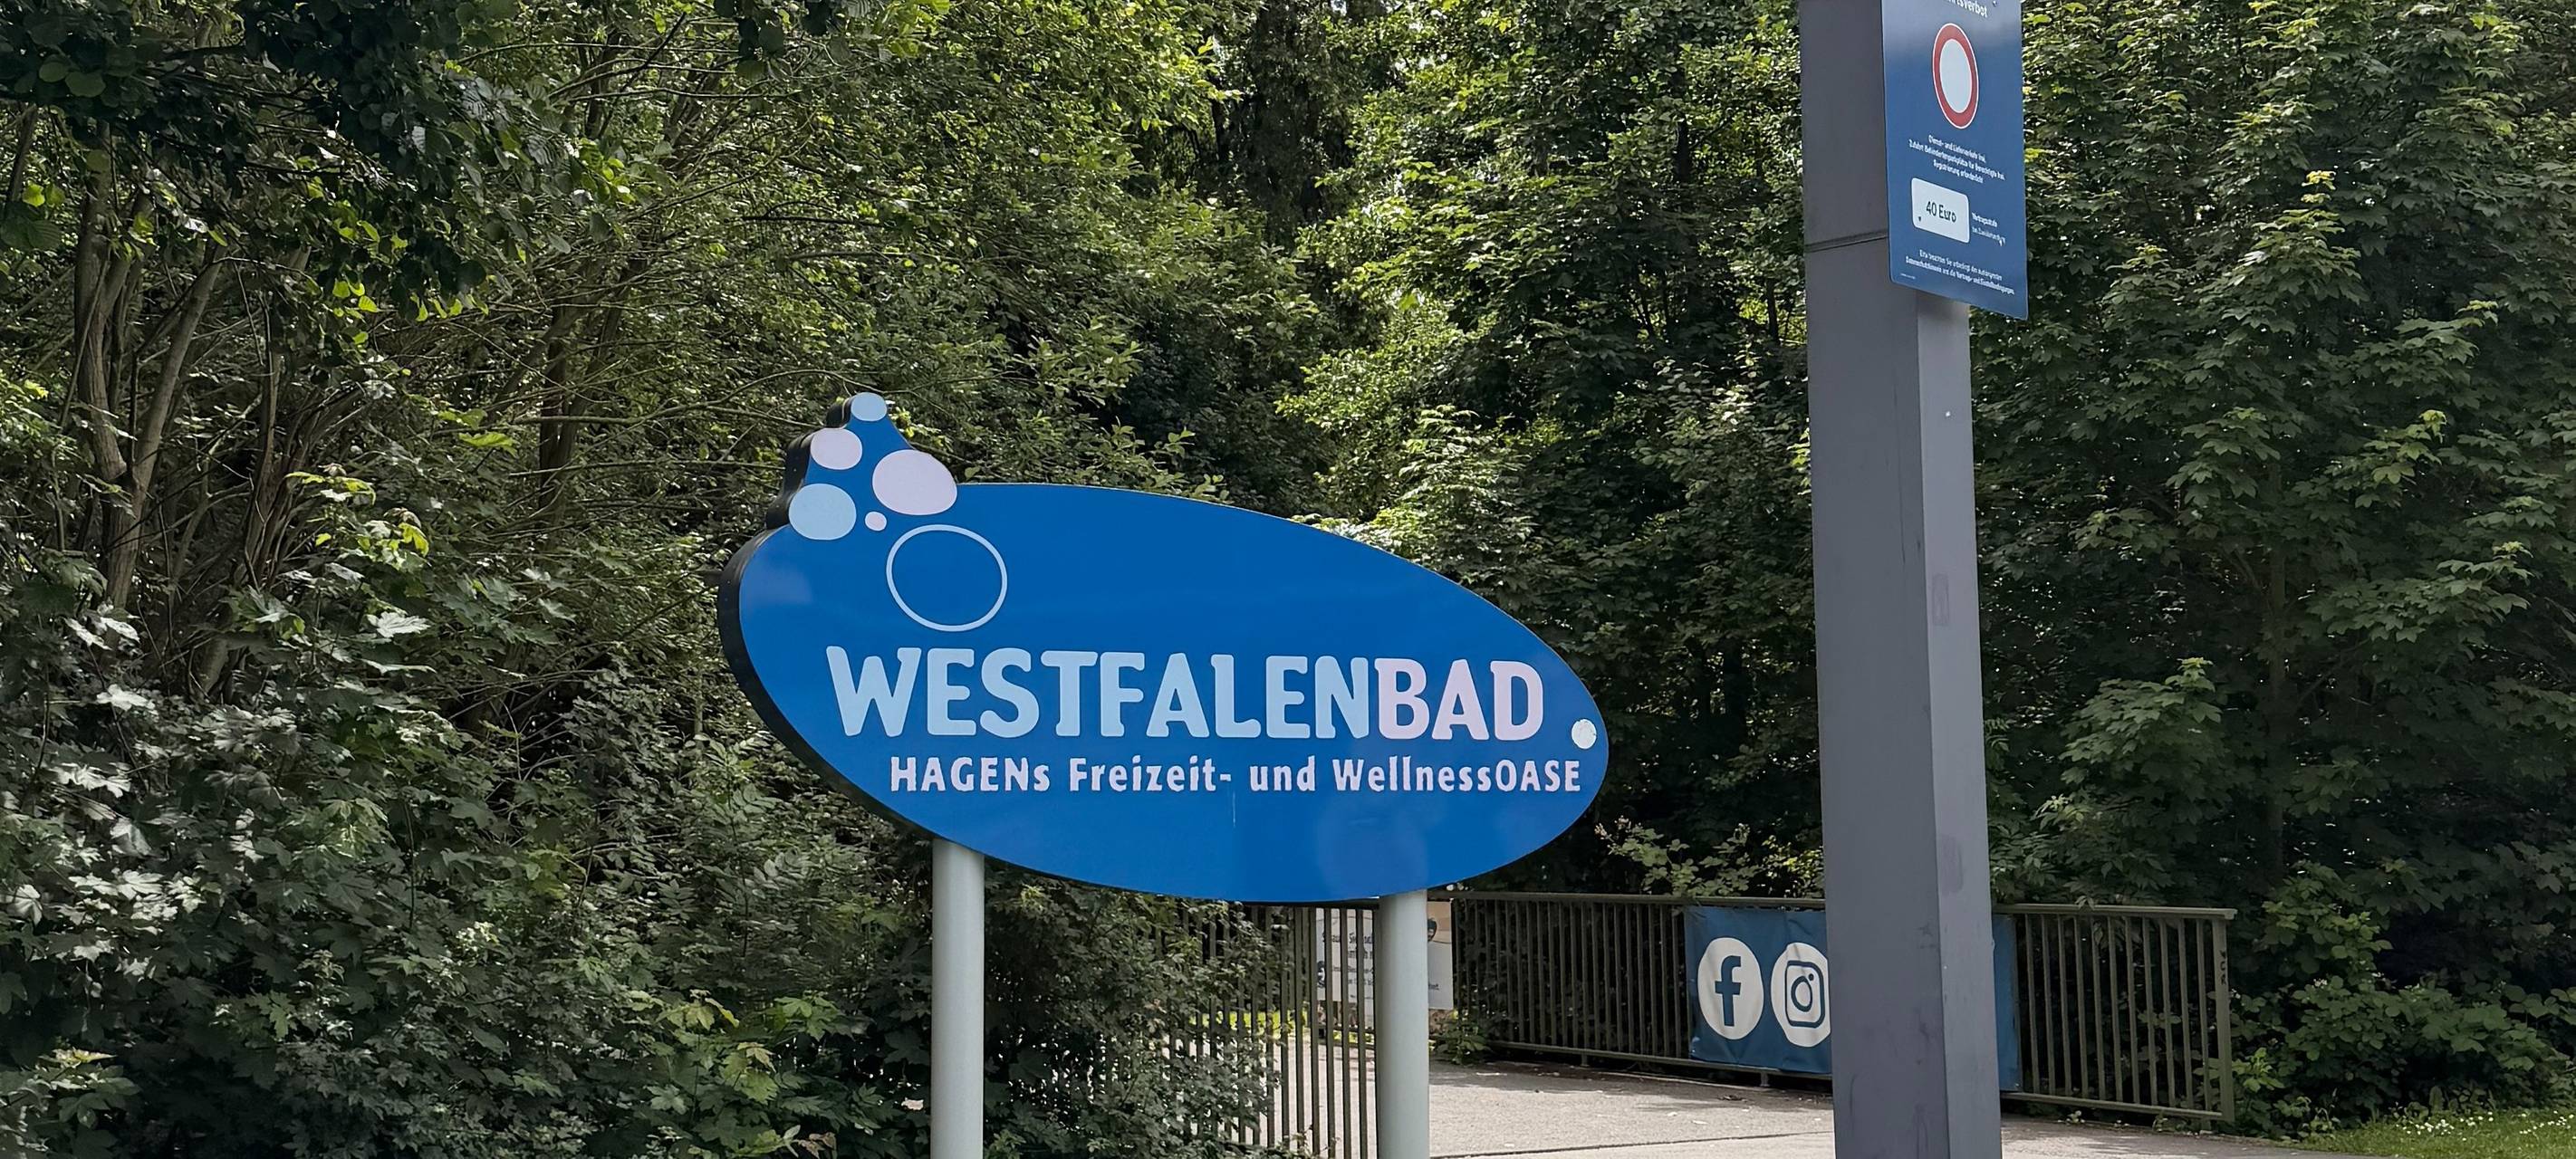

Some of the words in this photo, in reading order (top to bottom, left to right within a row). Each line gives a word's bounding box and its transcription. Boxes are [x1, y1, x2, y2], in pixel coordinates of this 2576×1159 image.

[1926, 201, 1937, 216] 40
[1938, 204, 1957, 224] Euro
[825, 646, 1544, 741] WESTFALENBAD
[890, 755, 1050, 792] HAGENs
[1069, 754, 1232, 792] Freizeit-
[1249, 755, 1315, 792] und
[1332, 754, 1581, 792] WellnessOASE
[1715, 955, 1741, 1027] f
